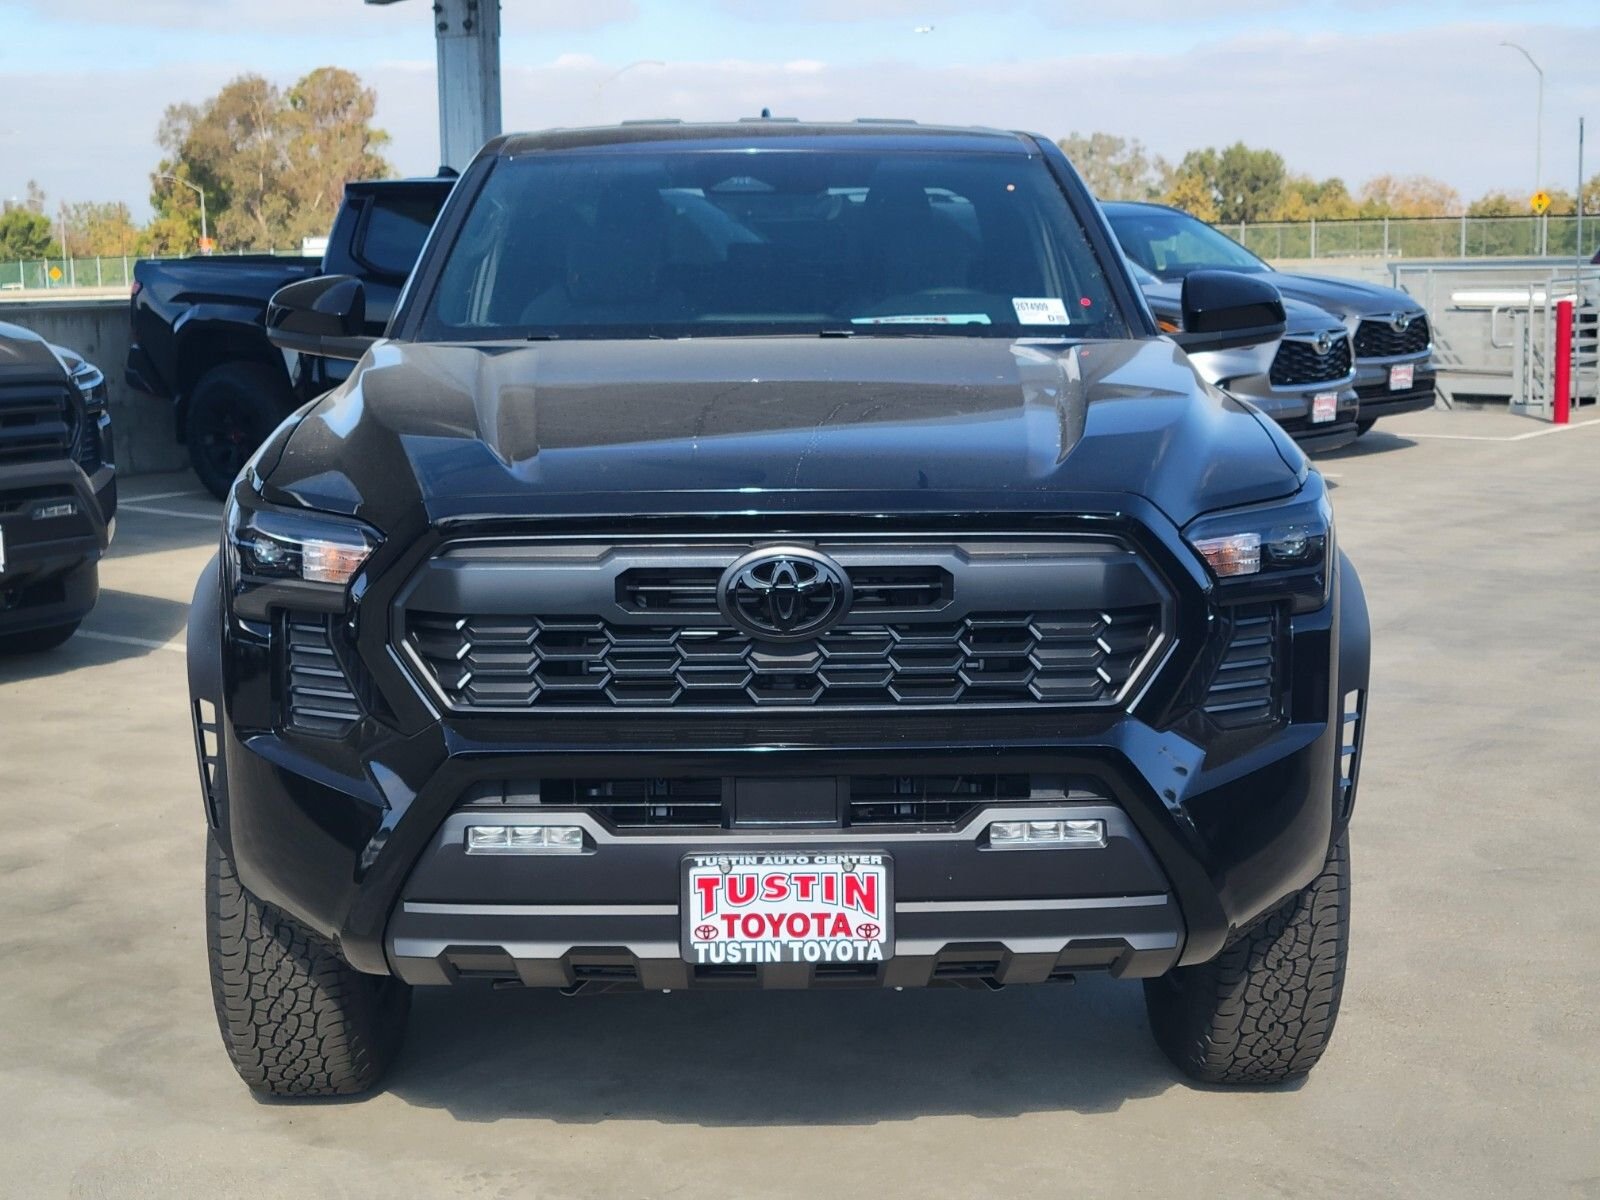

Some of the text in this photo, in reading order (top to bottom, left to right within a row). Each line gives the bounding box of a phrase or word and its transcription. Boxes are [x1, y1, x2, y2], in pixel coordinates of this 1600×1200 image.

[694, 855, 882, 866] TUSTIN AUTO CENTER
[694, 872, 879, 920] TUSTIN
[721, 912, 853, 938] TOYOTA
[694, 940, 883, 963] TUSTIN TOYOTA
